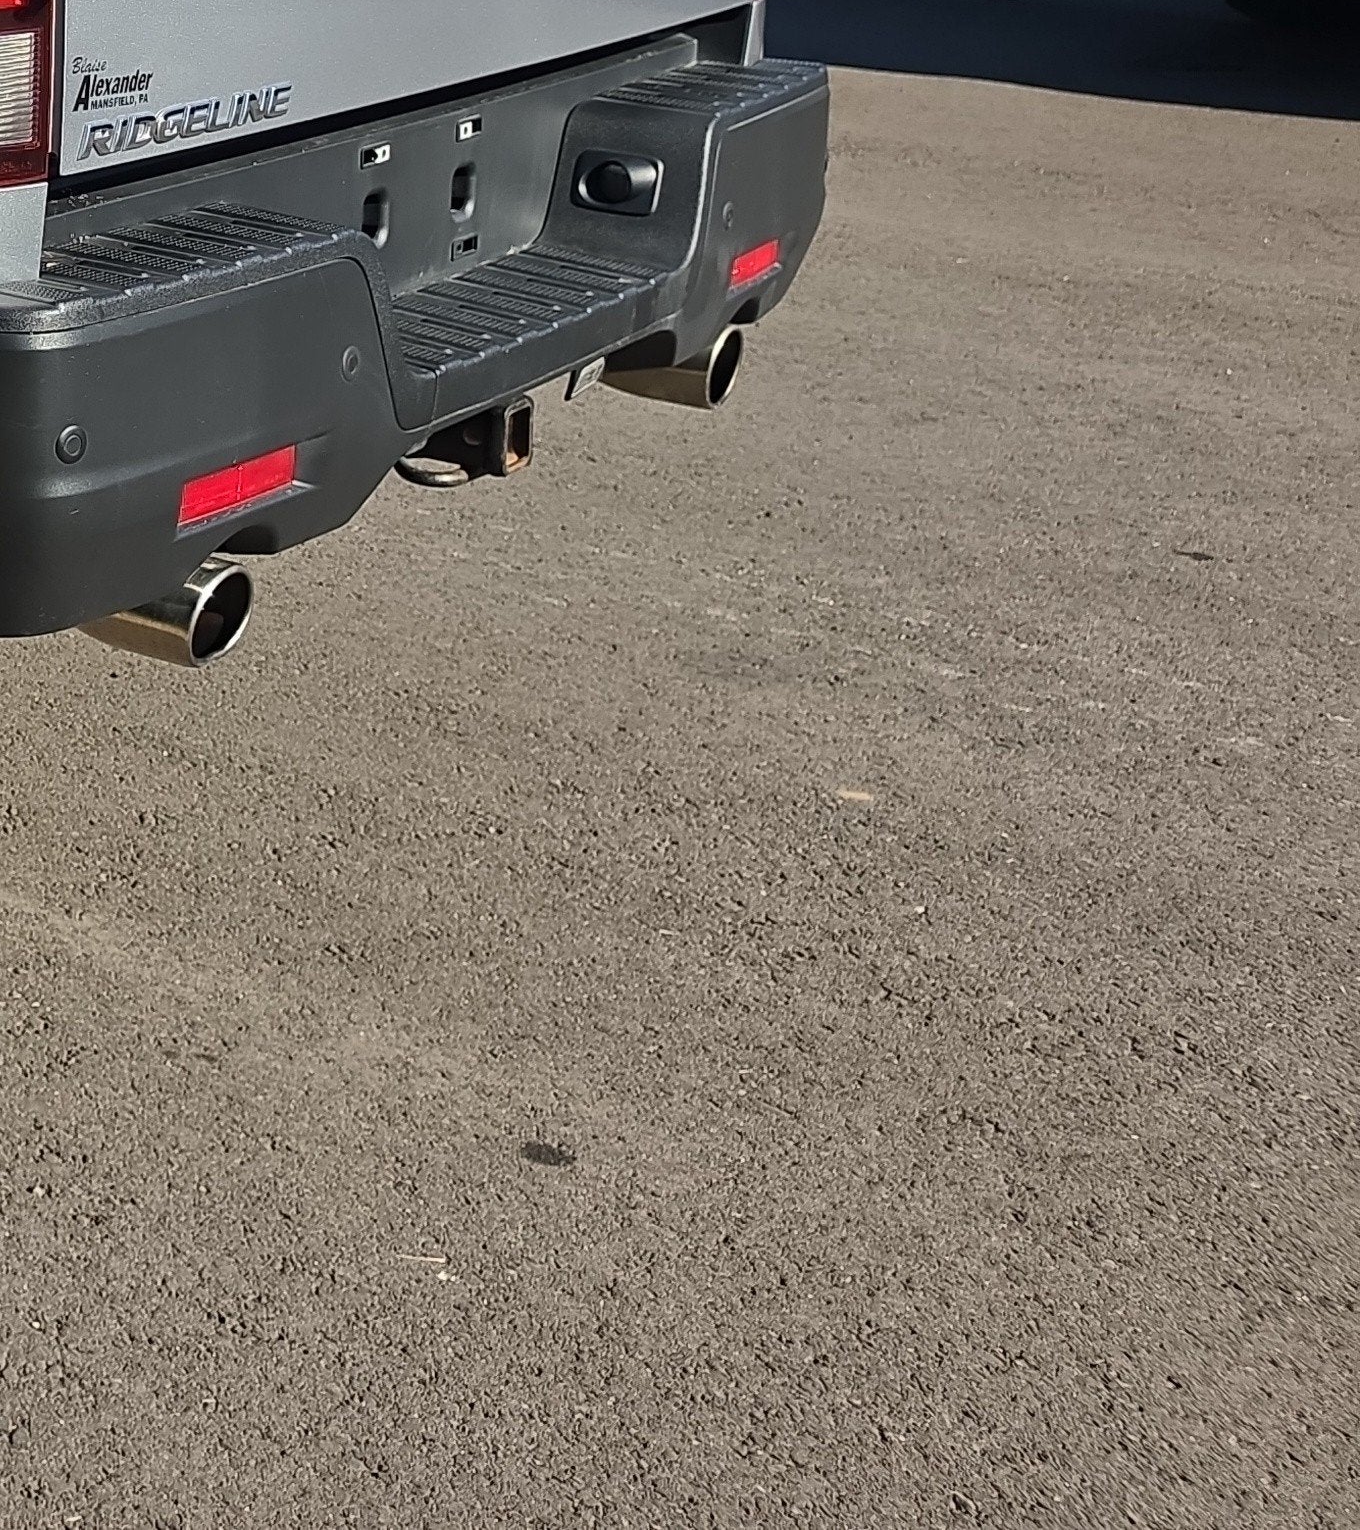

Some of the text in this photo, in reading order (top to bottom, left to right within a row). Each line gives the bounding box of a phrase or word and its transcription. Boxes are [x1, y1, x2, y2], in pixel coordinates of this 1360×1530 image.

[72, 56, 107, 75] Blaise
[72, 69, 153, 112] Alexander
[91, 93, 149, 110] MANSFIELD, PA
[76, 81, 292, 160] RIDGELINE
